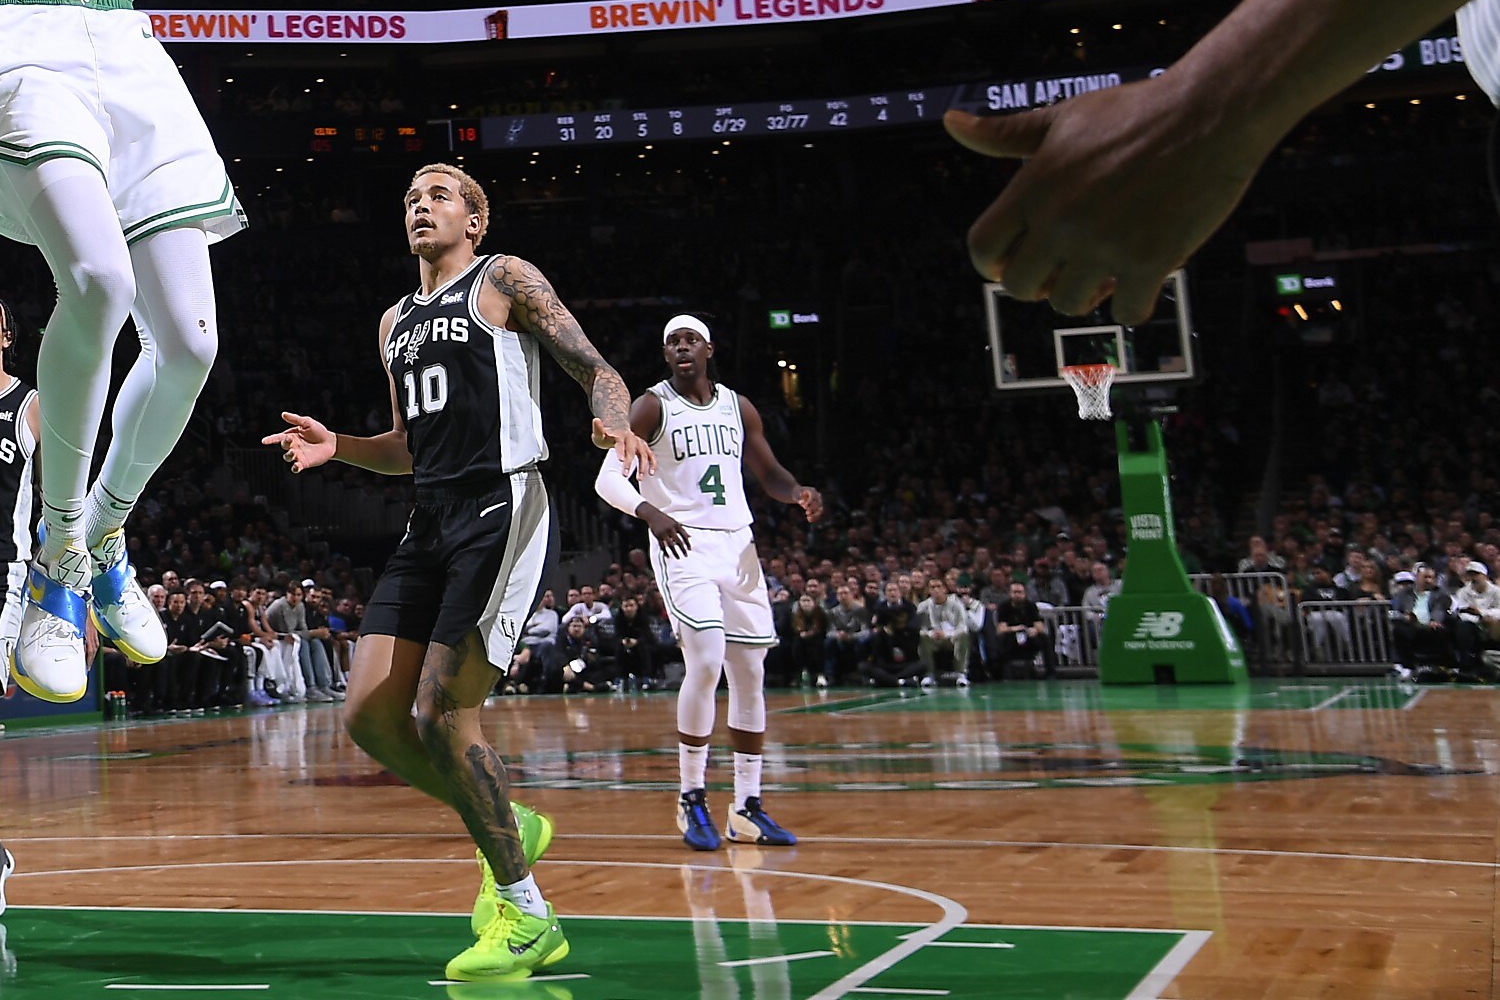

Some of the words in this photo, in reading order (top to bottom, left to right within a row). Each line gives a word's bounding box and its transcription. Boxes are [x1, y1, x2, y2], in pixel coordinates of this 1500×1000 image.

[267, 13, 406, 41] LEGENDS
[589, 0, 724, 30] BREWIN'
[986, 83, 1029, 110] SAN
[559, 127, 575, 141] 31
[595, 126, 613, 139] 20
[637, 124, 648, 137] 5
[672, 122, 683, 135] 8
[712, 118, 746, 133] 6/29
[767, 114, 809, 131] 32/77
[829, 112, 847, 126] 42
[877, 109, 888, 121] 4
[917, 104, 923, 118] 1
[594, 114, 611, 123] AST
[633, 112, 648, 121] STL
[458, 128, 476, 141] 18
[386, 317, 469, 370] SPURS
[403, 363, 448, 420] 10
[671, 424, 739, 461] CELTICS
[697, 464, 726, 505] 4
[1130, 513, 1162, 528] VISTA
[1131, 528, 1163, 540] PRINT
[1124, 641, 1146, 649] new
[1148, 640, 1194, 649] balance
